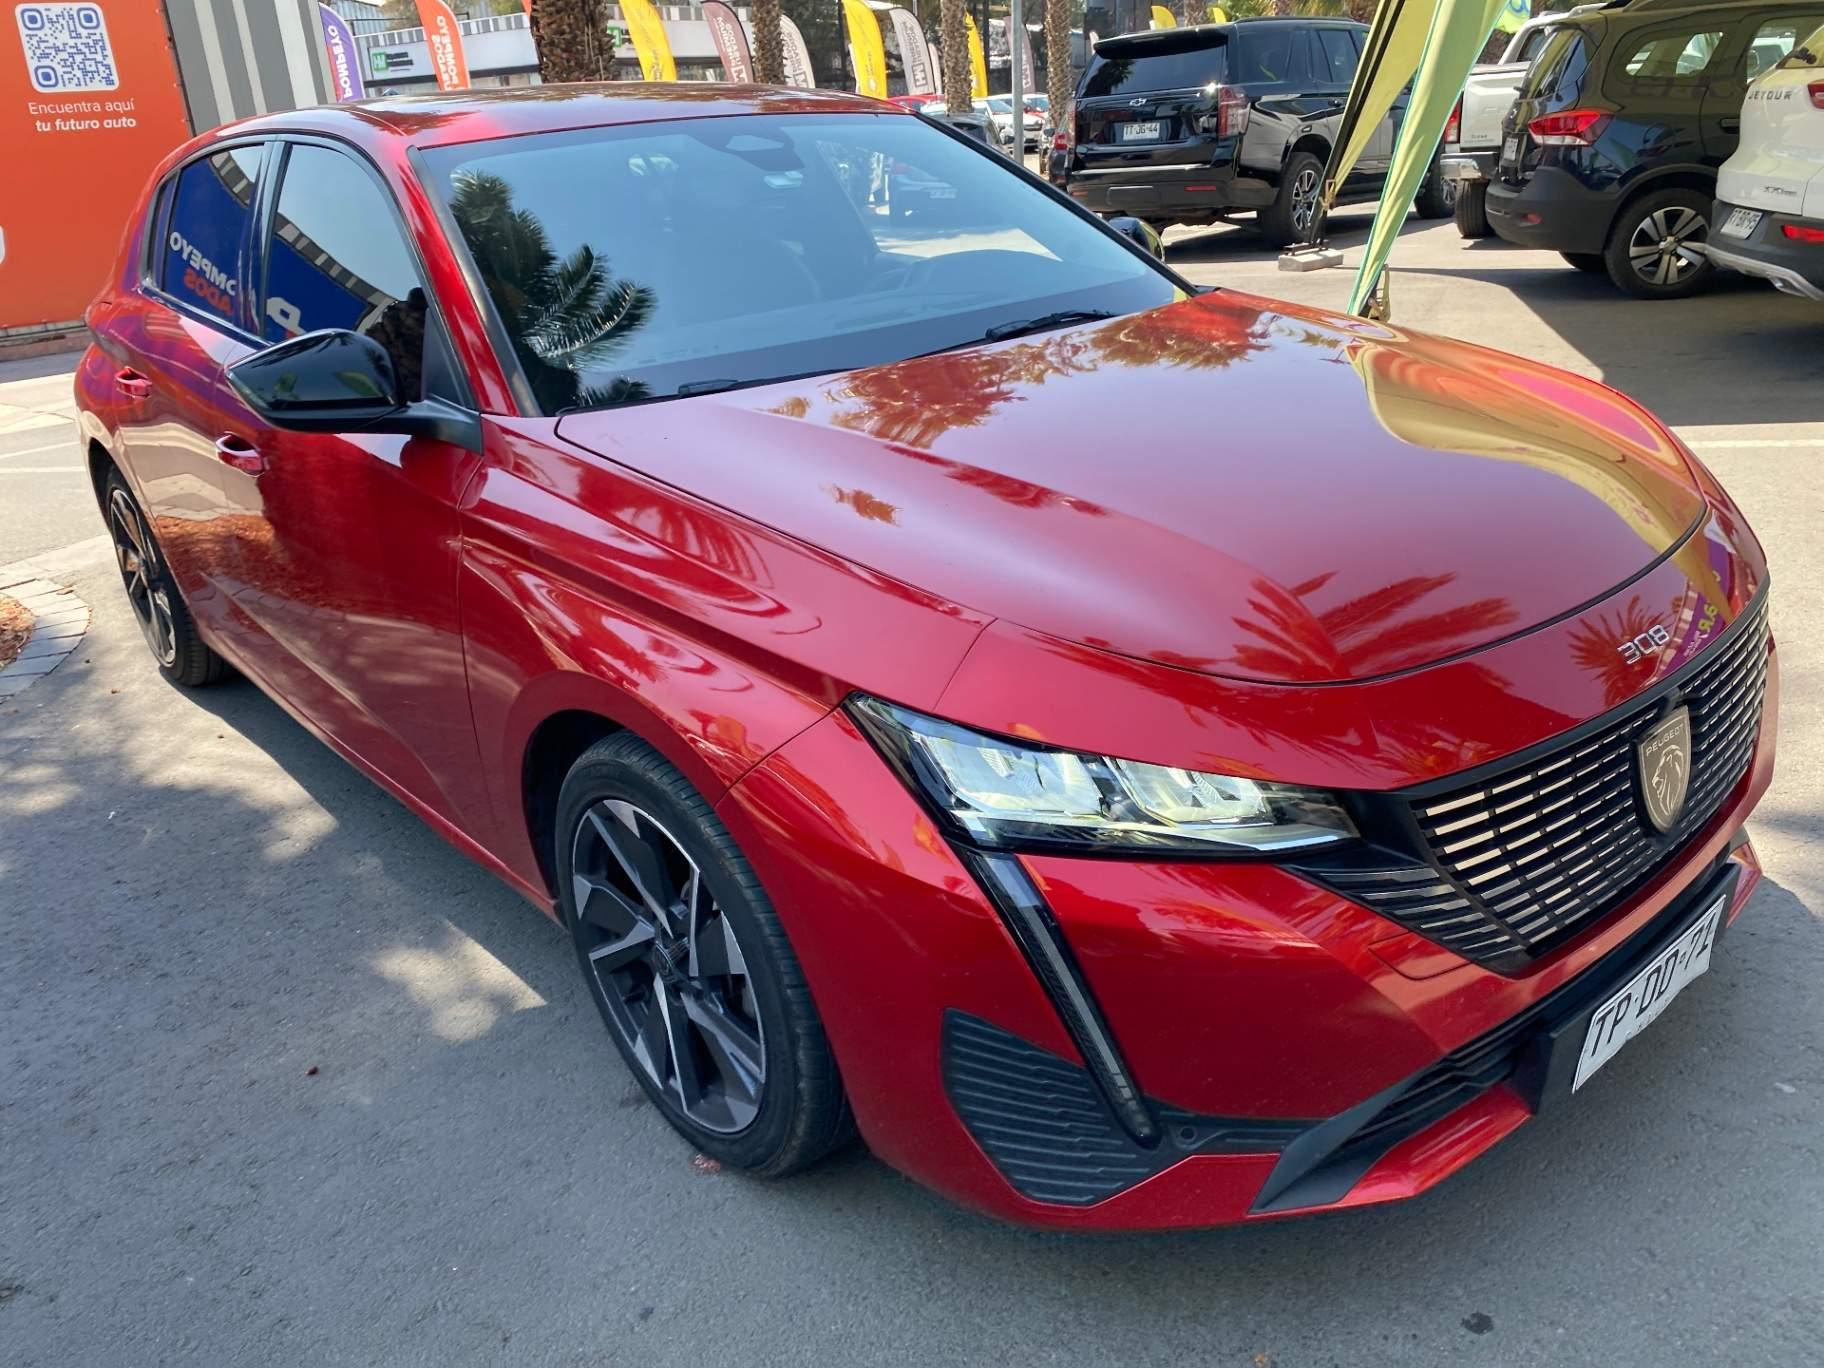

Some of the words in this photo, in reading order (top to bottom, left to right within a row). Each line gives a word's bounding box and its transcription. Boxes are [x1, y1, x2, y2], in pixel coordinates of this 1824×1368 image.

[1748, 90, 1792, 100] JETOUR
[28, 102, 101, 114] Encuentra
[105, 98, 134, 113] aquí
[35, 120, 51, 132] tu
[55, 118, 100, 131] futuro
[103, 117, 136, 128] auto
[1617, 624, 1670, 665] 308
[1645, 723, 1684, 758] PEUGEOT
